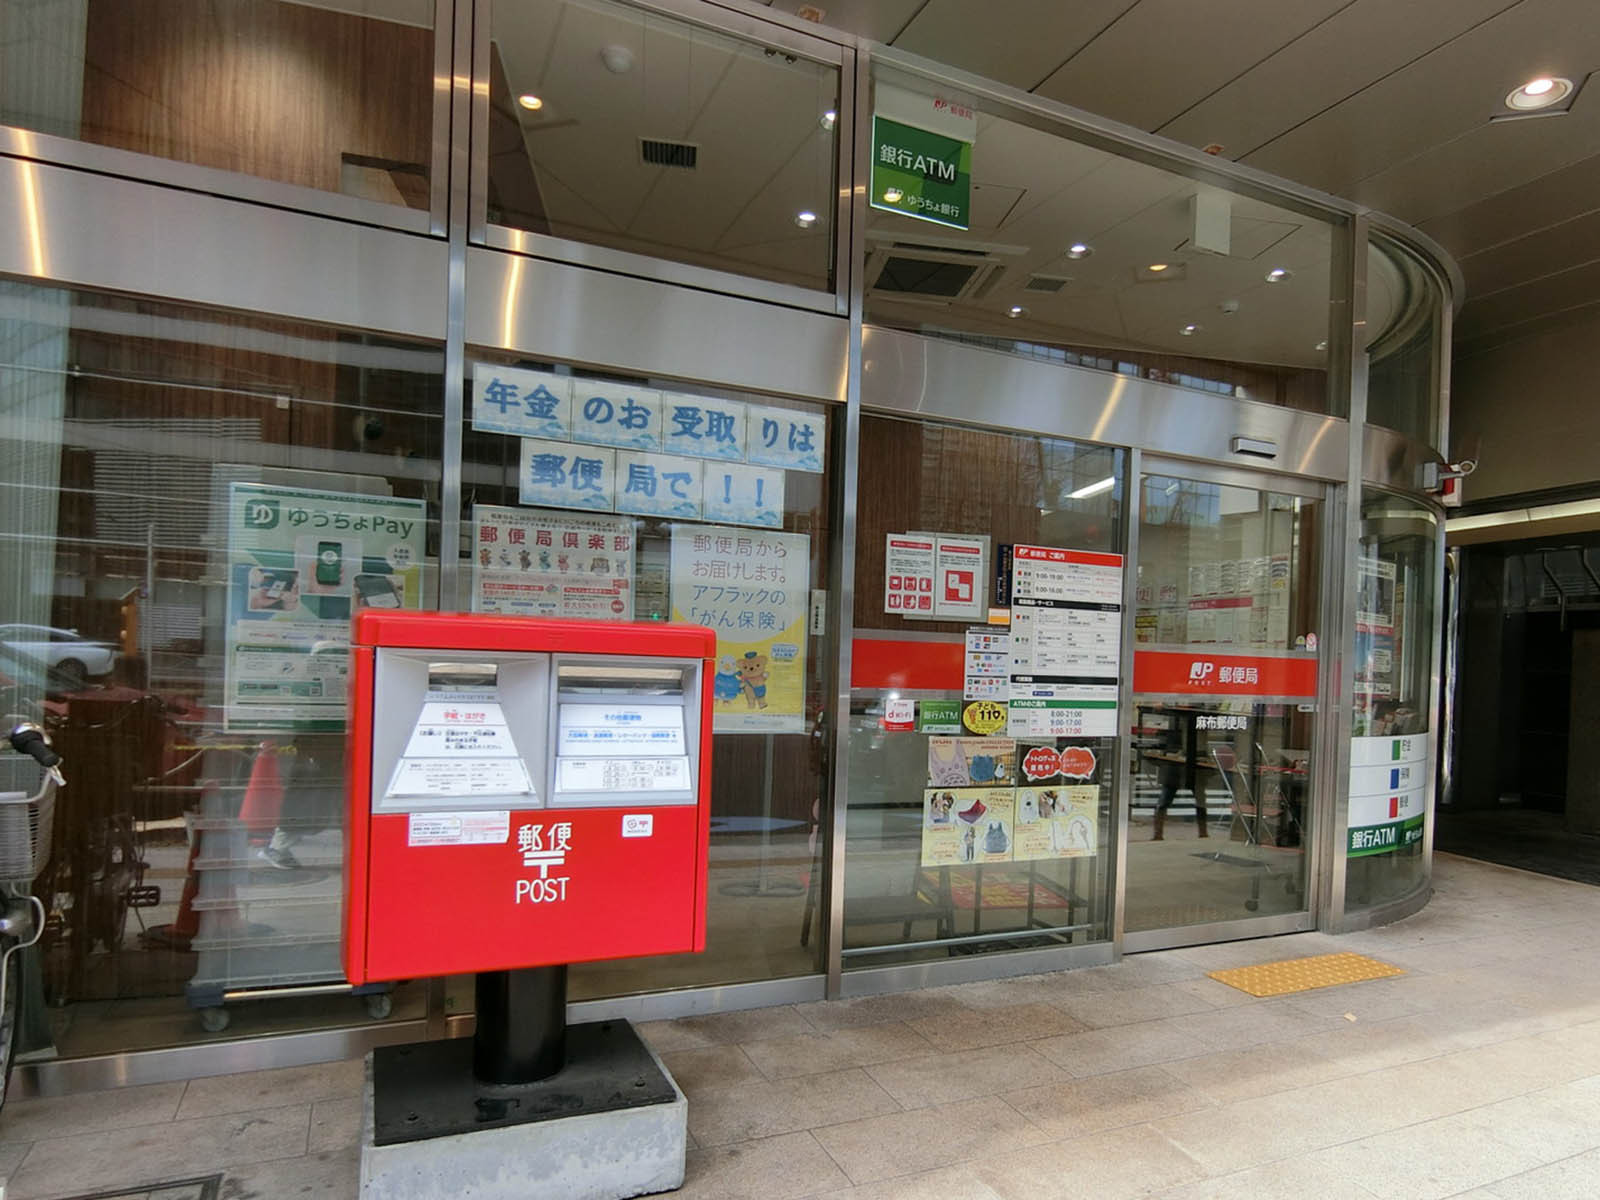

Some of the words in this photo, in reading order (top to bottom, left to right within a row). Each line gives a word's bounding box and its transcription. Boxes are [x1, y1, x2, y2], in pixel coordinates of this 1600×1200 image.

[880, 144, 955, 181] 銀行ATM
[907, 194, 960, 217] ゆうちょ銀行
[287, 509, 414, 540] ゆうちょPay
[480, 525, 631, 552] 郵便局倶楽部
[692, 534, 788, 559] 郵便局から
[692, 559, 787, 584] お届けします。
[692, 584, 787, 606] アフラックの
[690, 607, 786, 632] 「がん保険」
[1218, 666, 1258, 685] 郵便局
[1195, 715, 1248, 731] 麻布郵便局
[517, 821, 573, 853] 郵便
[1351, 826, 1396, 850] 銀行ATM
[516, 876, 571, 904] POST
